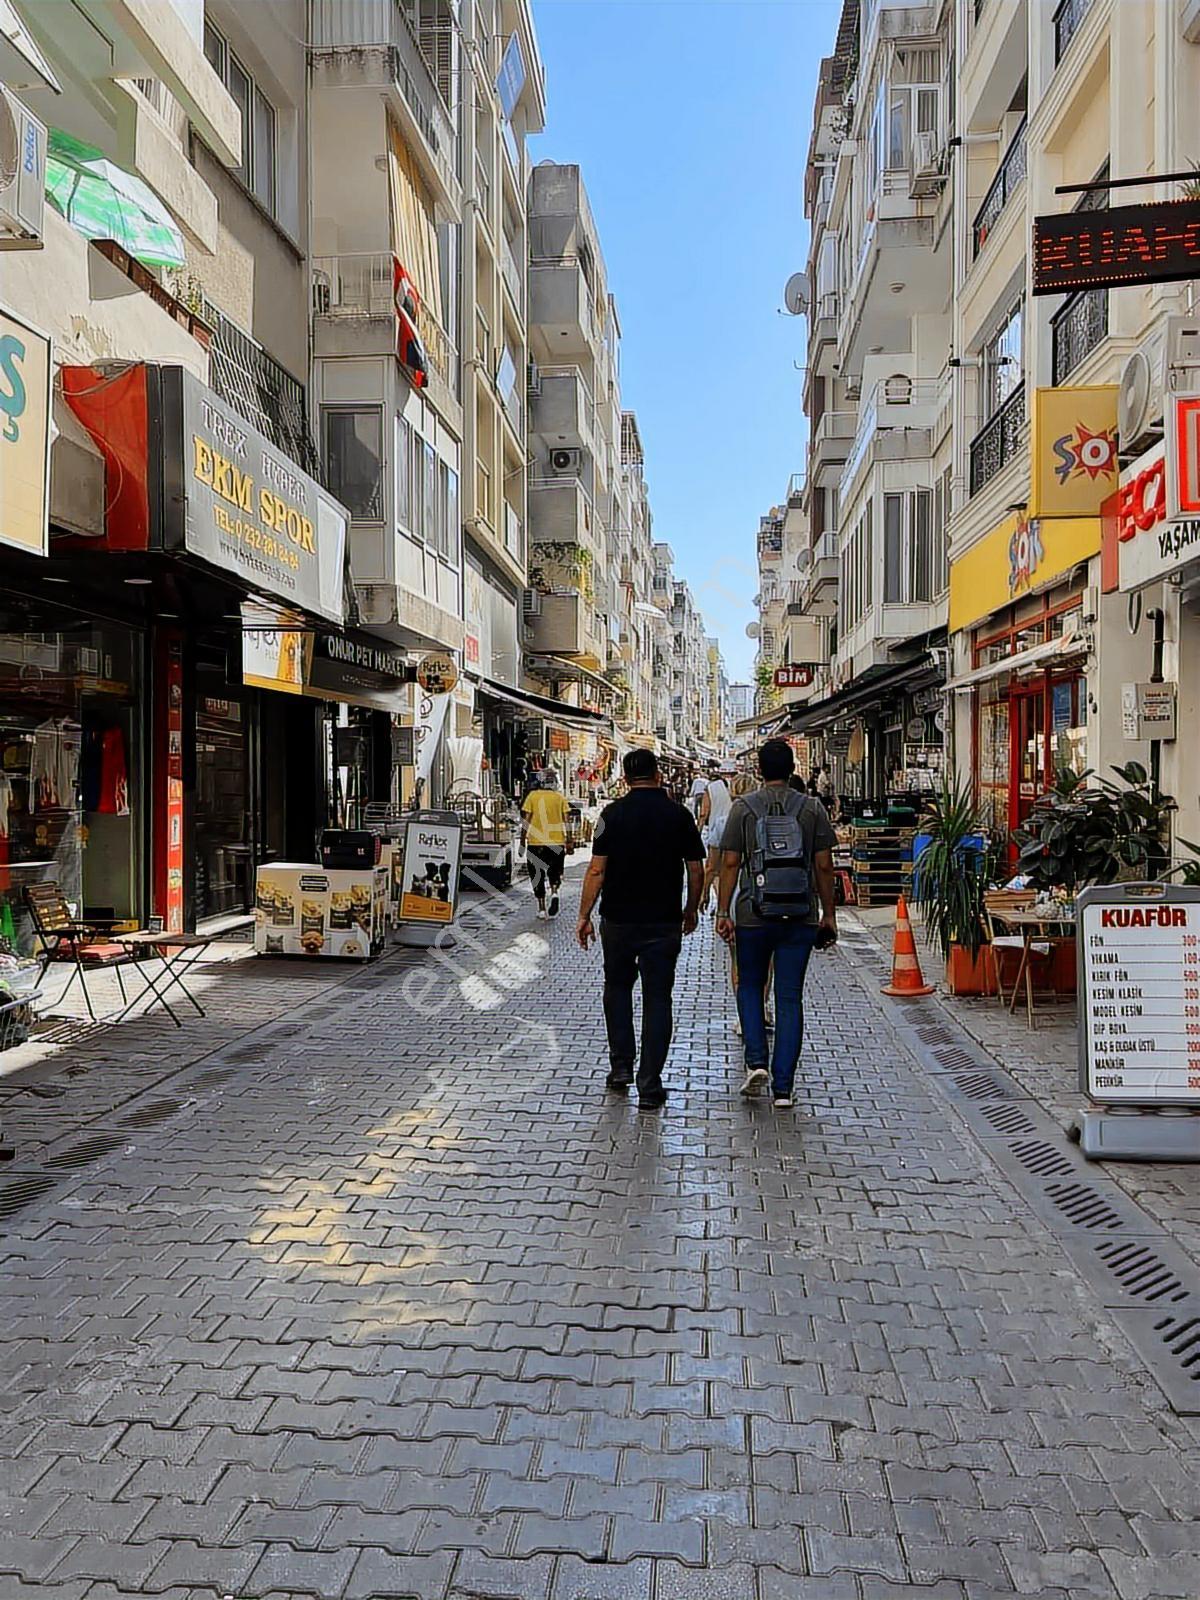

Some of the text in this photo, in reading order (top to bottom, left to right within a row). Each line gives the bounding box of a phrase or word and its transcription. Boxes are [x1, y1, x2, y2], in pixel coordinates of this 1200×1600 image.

[193, 434, 315, 555] EKM SPOR
[356, 645, 372, 667] PET
[423, 660, 451, 674] Reflex
[778, 668, 807, 683] BİM
[418, 832, 448, 847] Reflex
[1102, 906, 1186, 927] KUAFÖR
[1090, 934, 1104, 947] FÖN
[1091, 953, 1119, 965] YIKAMA
[1114, 968, 1128, 981] FÖN
[1093, 986, 1115, 1000] KESİM
[1118, 985, 1142, 999] KLASİK
[1093, 1005, 1116, 1017] MODEL
[1121, 1003, 1143, 1017] KESİM
[1094, 1022, 1105, 1035] DİP
[1109, 1023, 1127, 1035] BOYA
[1095, 1057, 1125, 1070] MANİKÜR
[1096, 1075, 1124, 1088] PEDİKÜR
